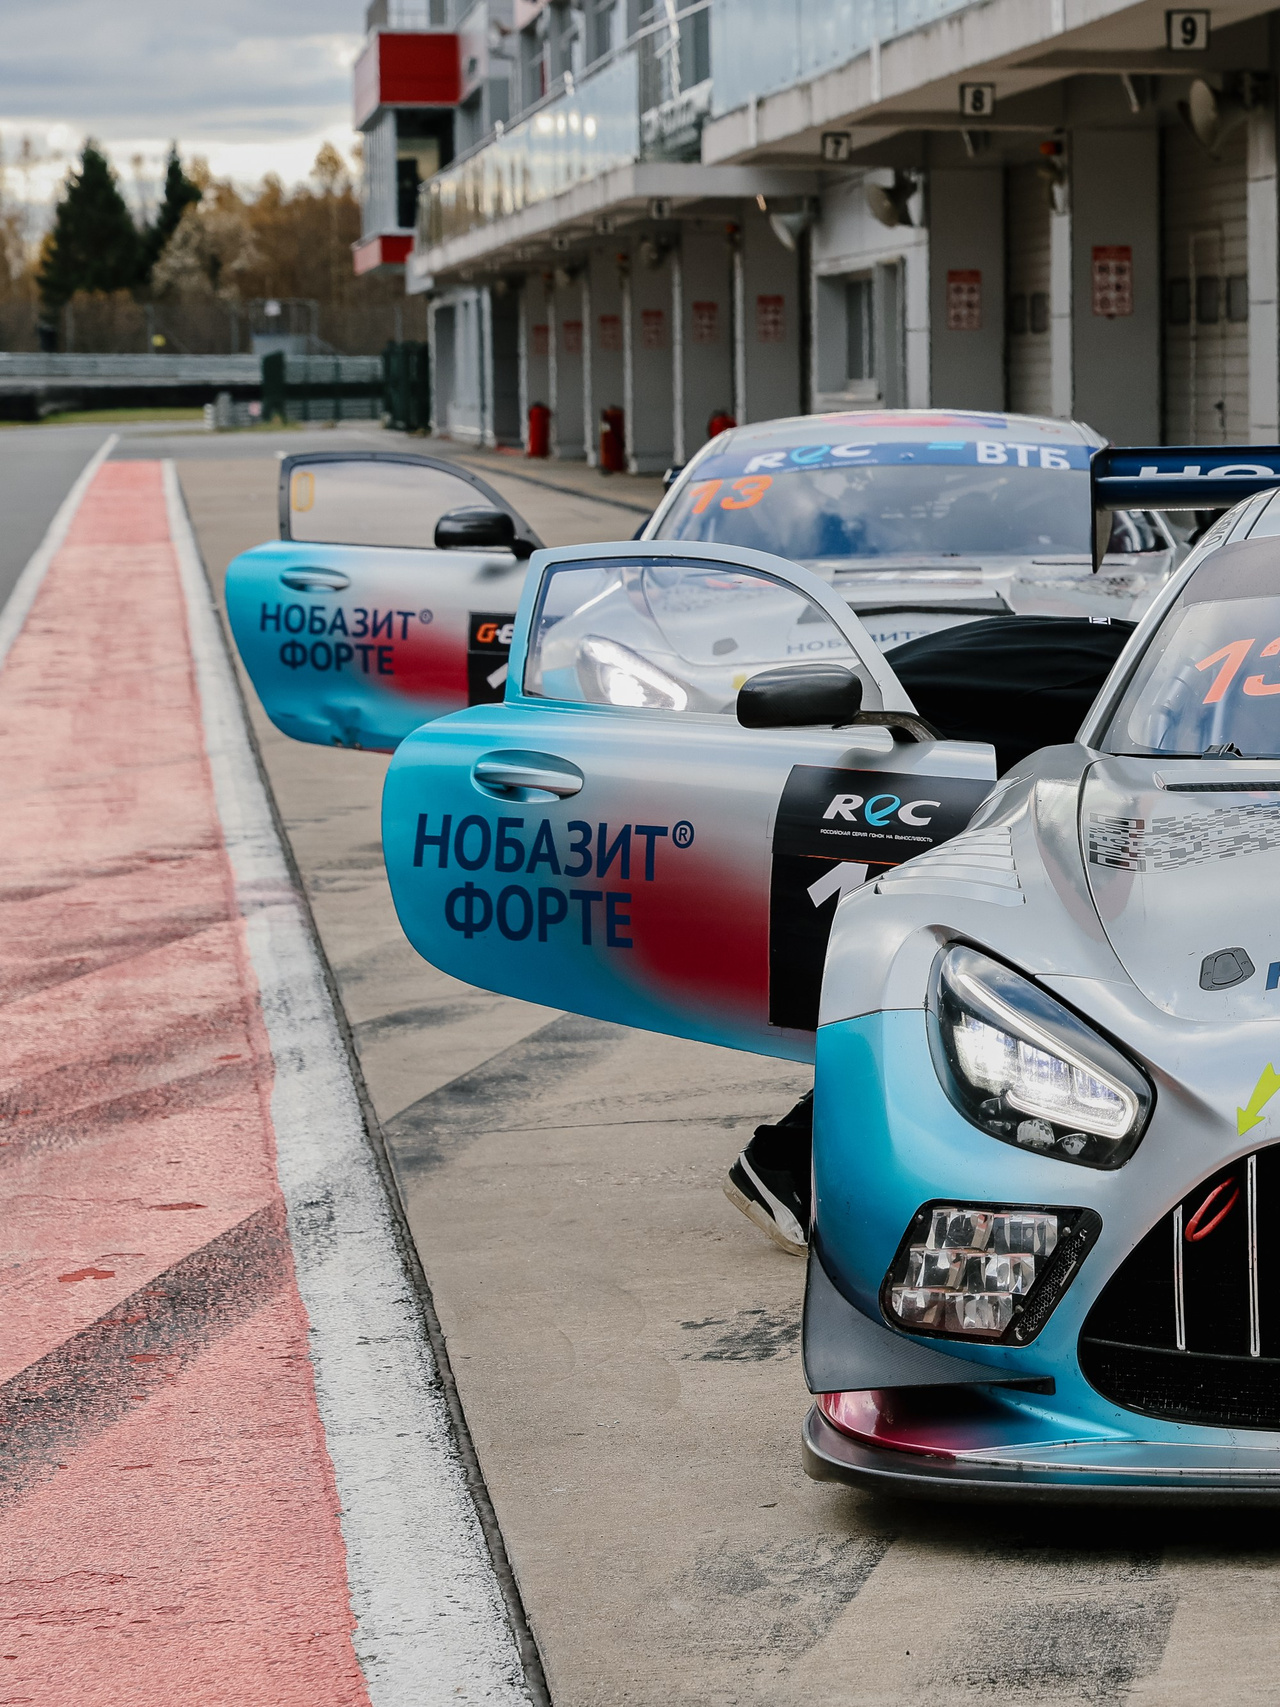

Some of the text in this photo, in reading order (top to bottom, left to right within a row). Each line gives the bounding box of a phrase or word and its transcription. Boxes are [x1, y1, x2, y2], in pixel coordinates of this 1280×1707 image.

[1180, 16, 1198, 46] 9
[971, 88, 985, 113] 8
[976, 441, 1072, 471] ВТБ
[688, 475, 774, 515] 13
[279, 640, 396, 675] ФОРТЕ
[444, 881, 634, 949] ФОРТЕ
